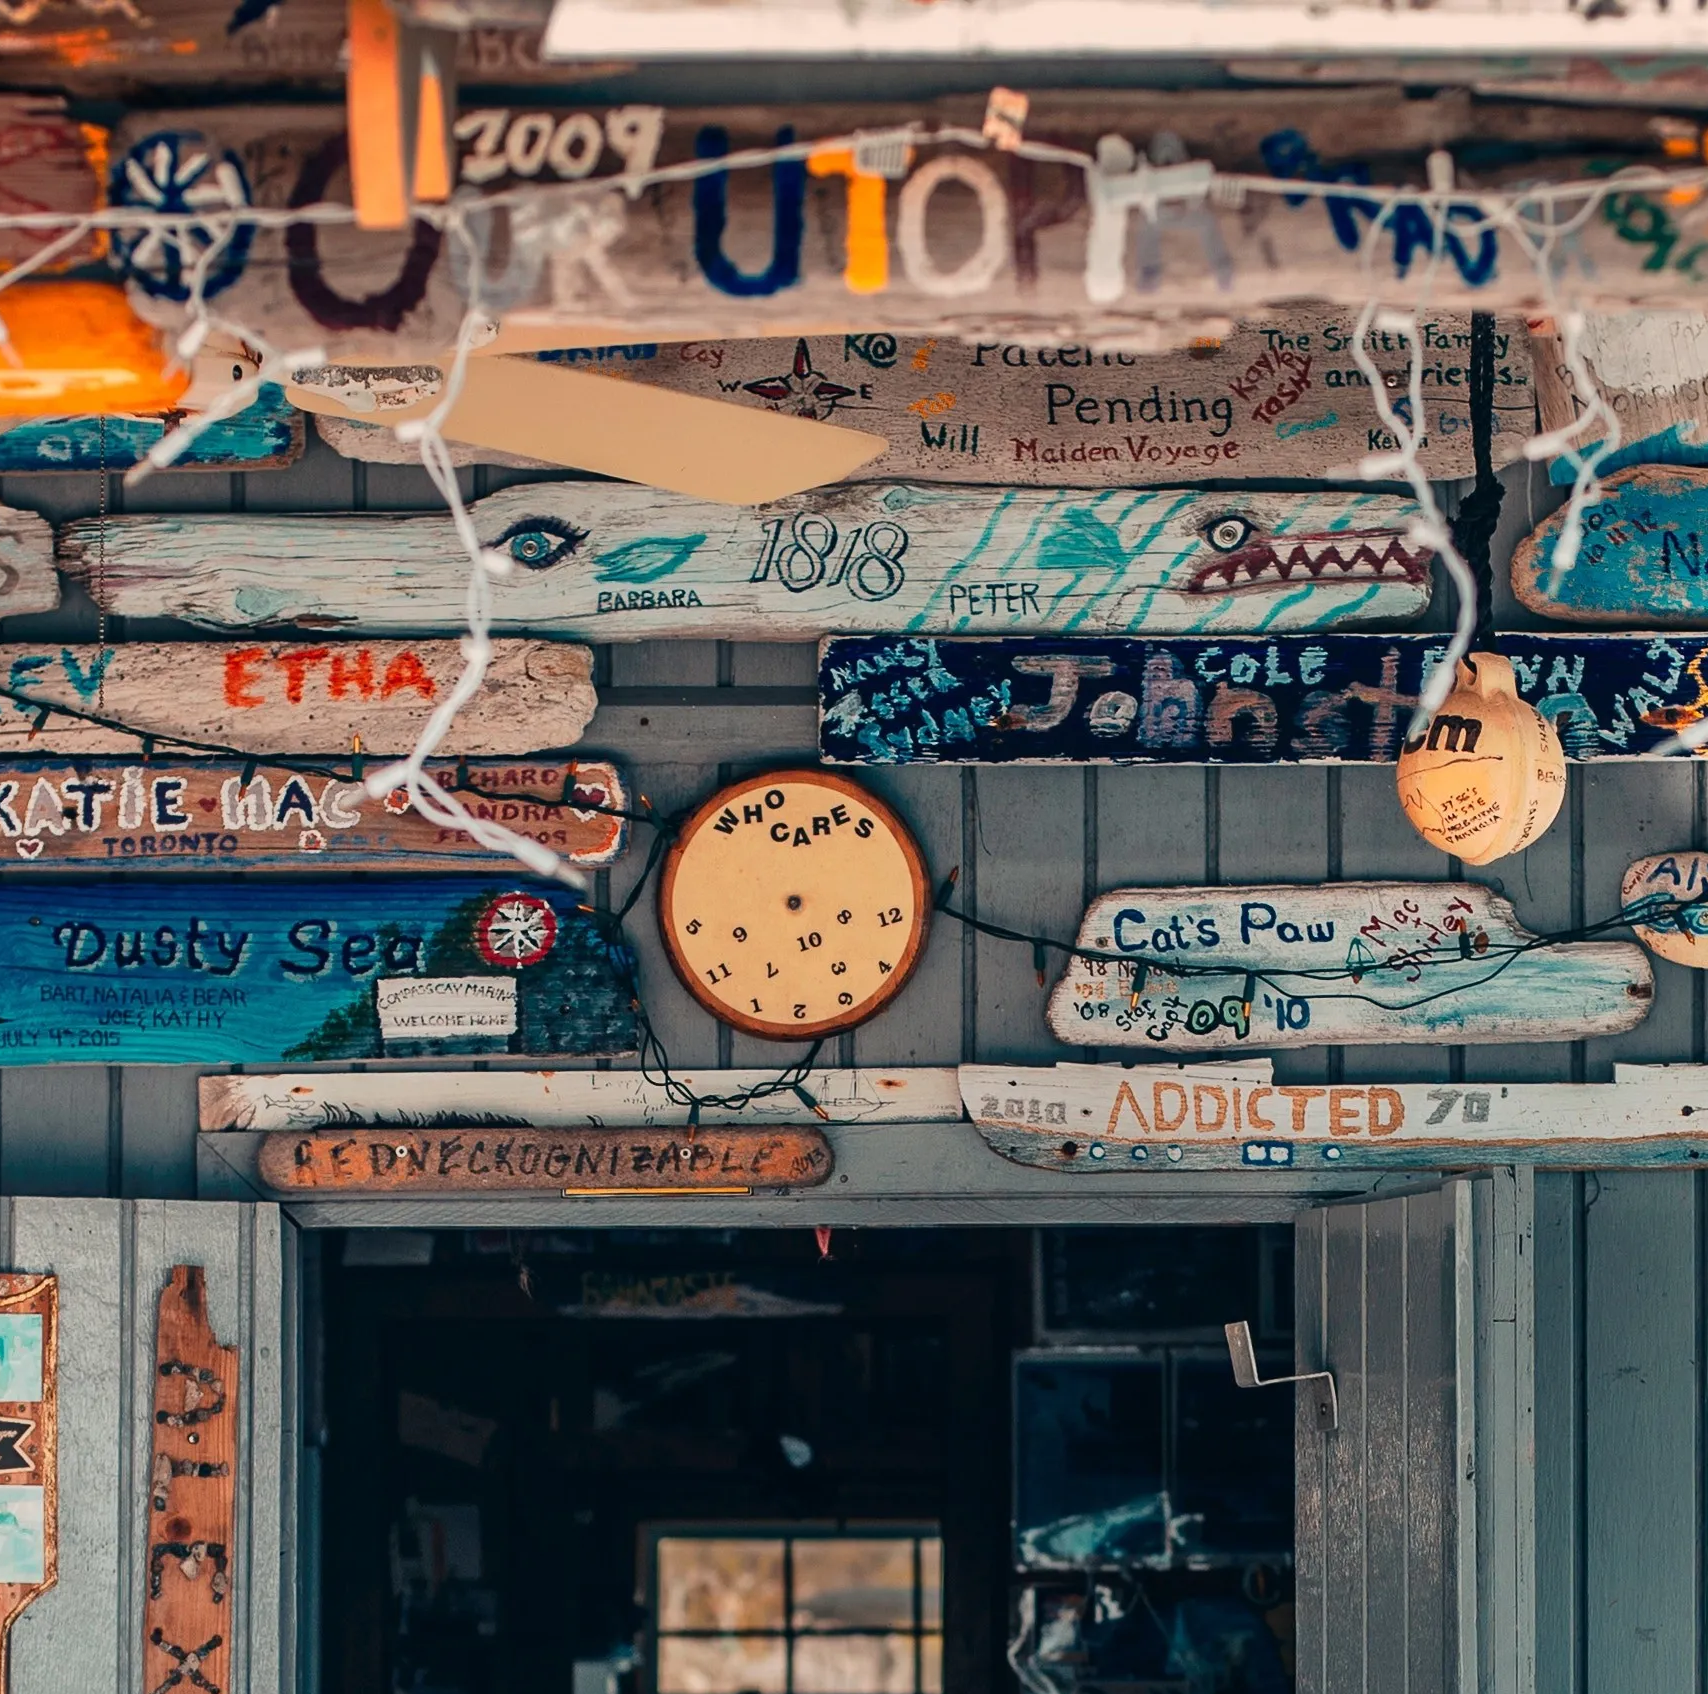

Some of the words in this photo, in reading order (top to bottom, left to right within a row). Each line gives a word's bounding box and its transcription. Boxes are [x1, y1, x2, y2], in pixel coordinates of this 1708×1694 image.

[455, 103, 664, 195] 2009
[1259, 328, 1310, 353] The
[1046, 382, 1234, 438] Pending
[920, 420, 980, 456] Will
[1010, 437, 1120, 463] Maiden
[1123, 434, 1241, 465] Voyage
[748, 511, 909, 603] 1818
[596, 586, 703, 616] BARBARA
[948, 581, 1041, 617] PETER
[1194, 643, 1329, 688] COLE
[713, 789, 786, 836] WHO
[769, 803, 876, 848] CARES
[103, 832, 239, 858] TORONTO
[685, 917, 703, 936] 5
[876, 906, 904, 929] 12
[1112, 907, 1219, 953] Cat's
[1239, 902, 1336, 946] Paw
[52, 916, 257, 978] Dusty
[278, 916, 429, 980] Sea
[796, 930, 824, 953] 10
[705, 961, 734, 985] 11
[876, 959, 893, 976] 4
[92, 984, 177, 1009] NATALIA
[192, 984, 248, 1010] BEAR
[378, 984, 431, 1010] COMPASS
[749, 997, 763, 1014] 1
[152, 1007, 227, 1029] KATHY
[392, 1013, 466, 1030] WELCOME
[468, 1013, 511, 1030] HOME
[76, 1027, 122, 1048] 2015
[1106, 1080, 1406, 1138] ADDICTED
